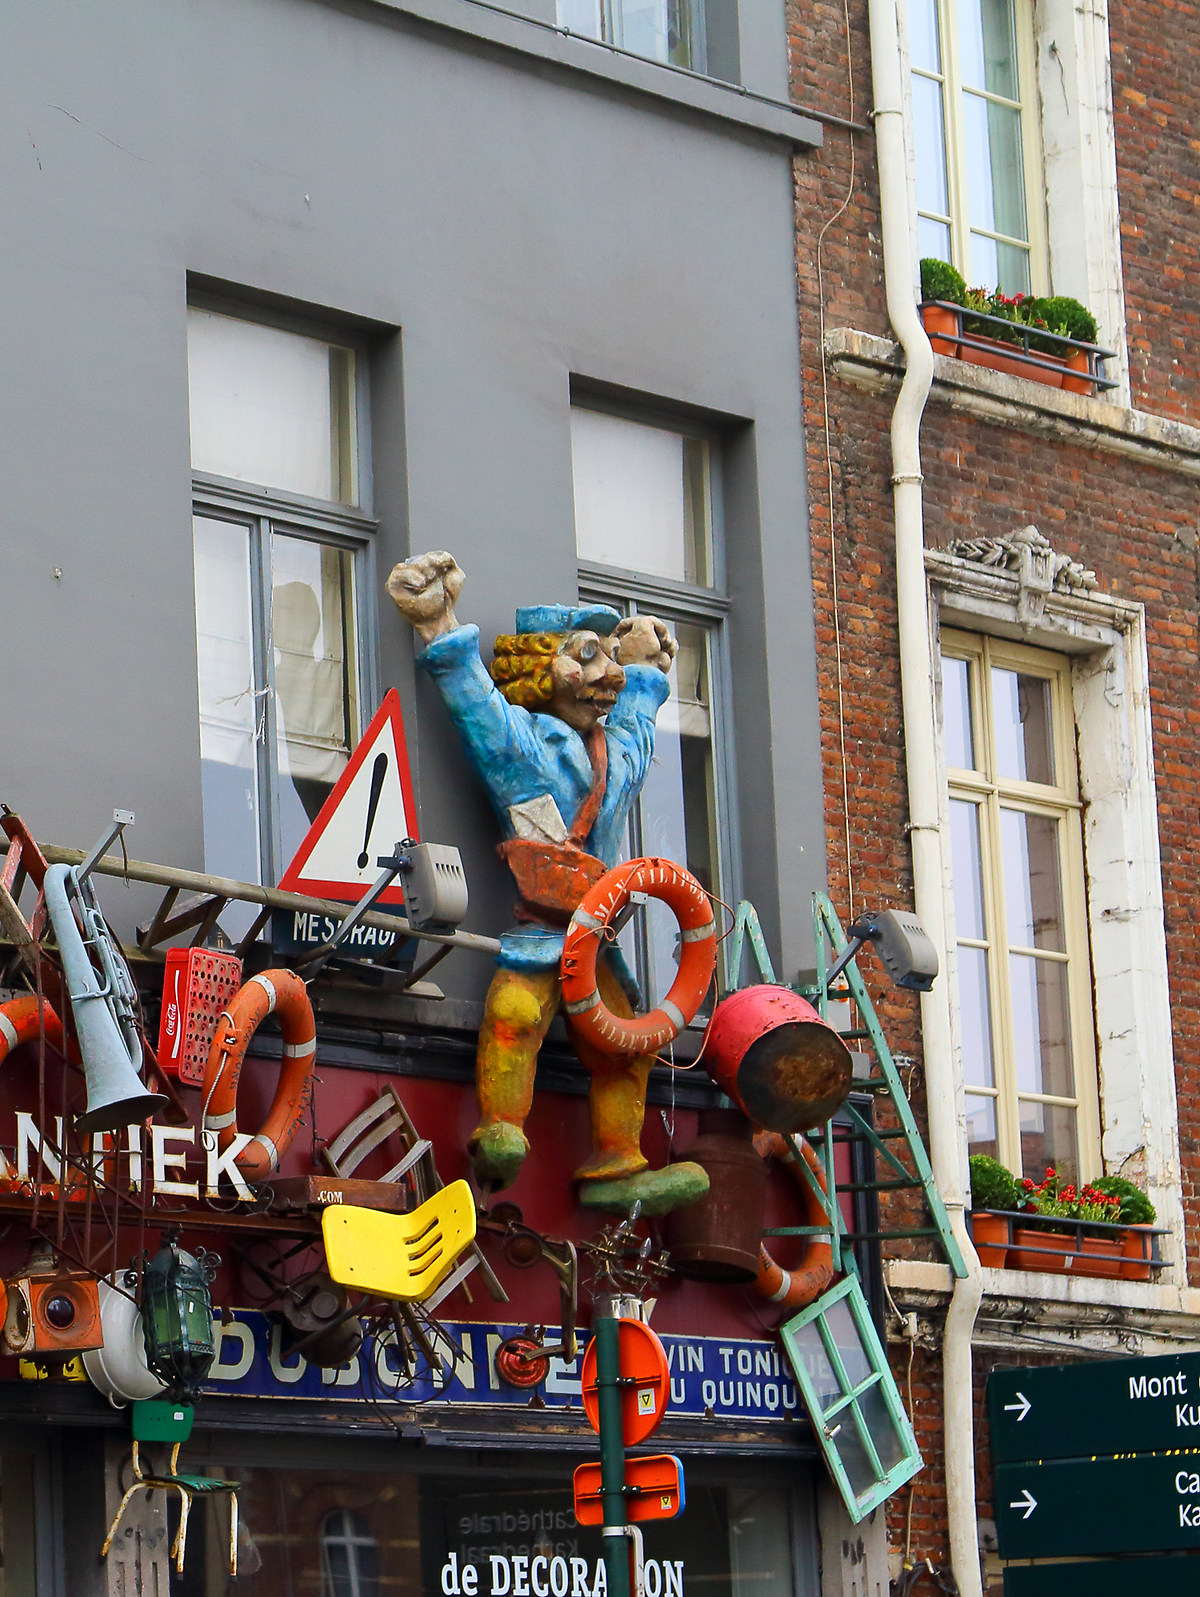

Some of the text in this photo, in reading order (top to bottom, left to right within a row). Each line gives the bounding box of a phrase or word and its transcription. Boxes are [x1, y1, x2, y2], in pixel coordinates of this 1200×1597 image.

[293, 911, 396, 947] MESRAG
[317, 1190, 343, 1204] .COM
[670, 1378, 686, 1404] U
[1129, 1371, 1188, 1400] Mont
[440, 1552, 684, 1597] de DECORAON
